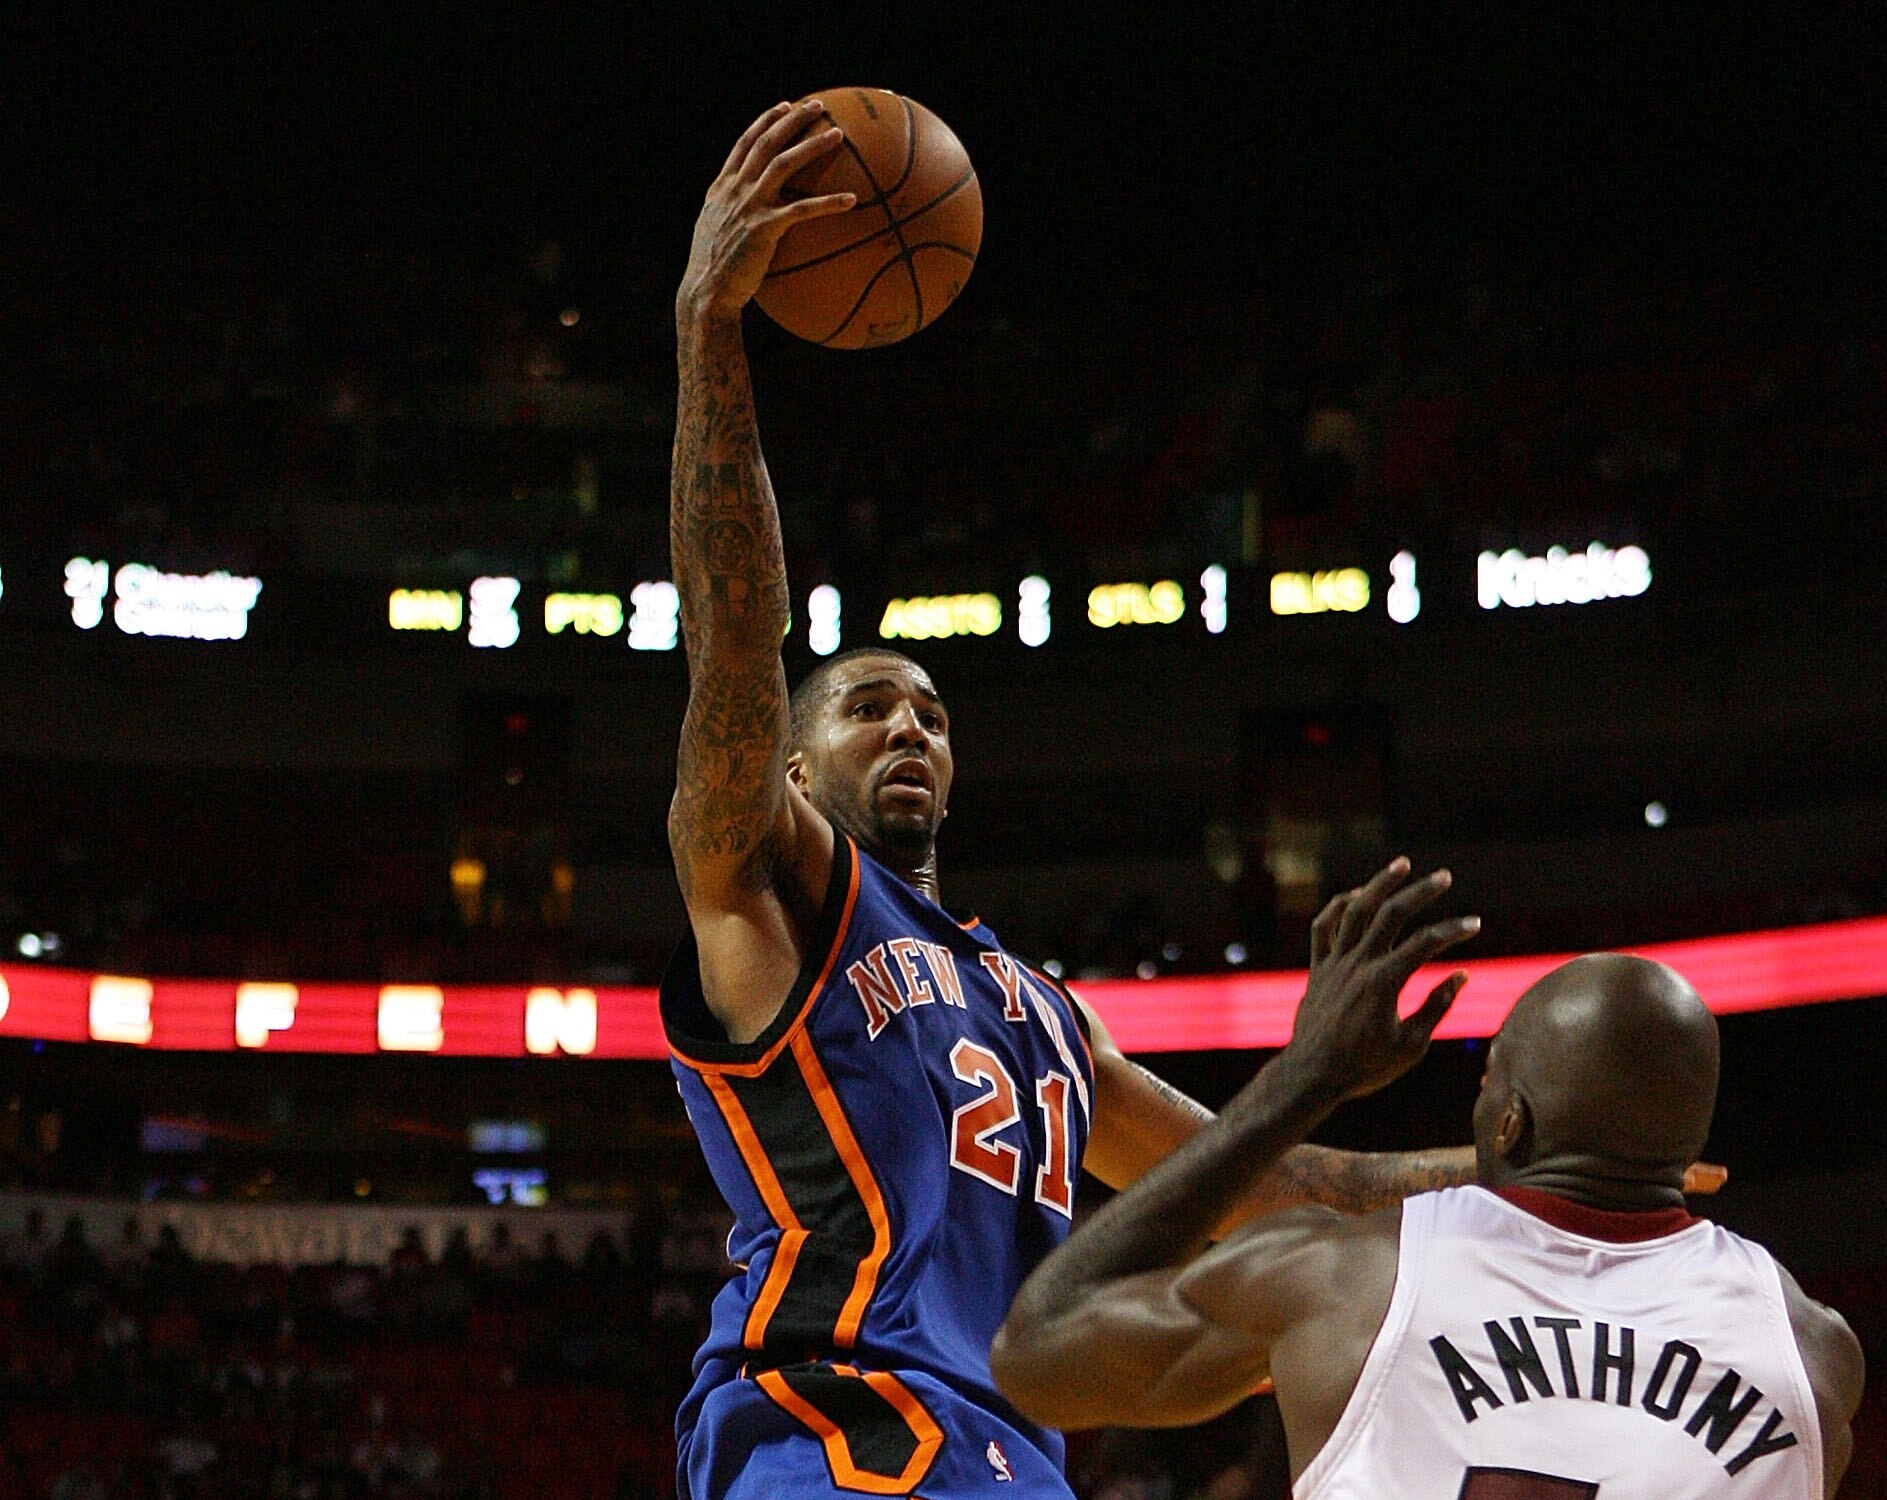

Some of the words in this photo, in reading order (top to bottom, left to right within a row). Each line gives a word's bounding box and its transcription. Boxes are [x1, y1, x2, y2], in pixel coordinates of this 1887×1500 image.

[1478, 540, 1653, 610] Knicks
[0, 973, 597, 1055] EFEN
[846, 937, 966, 1041] NEW
[948, 1037, 1072, 1221] 21
[1428, 1316, 1797, 1477] ANTHONY
